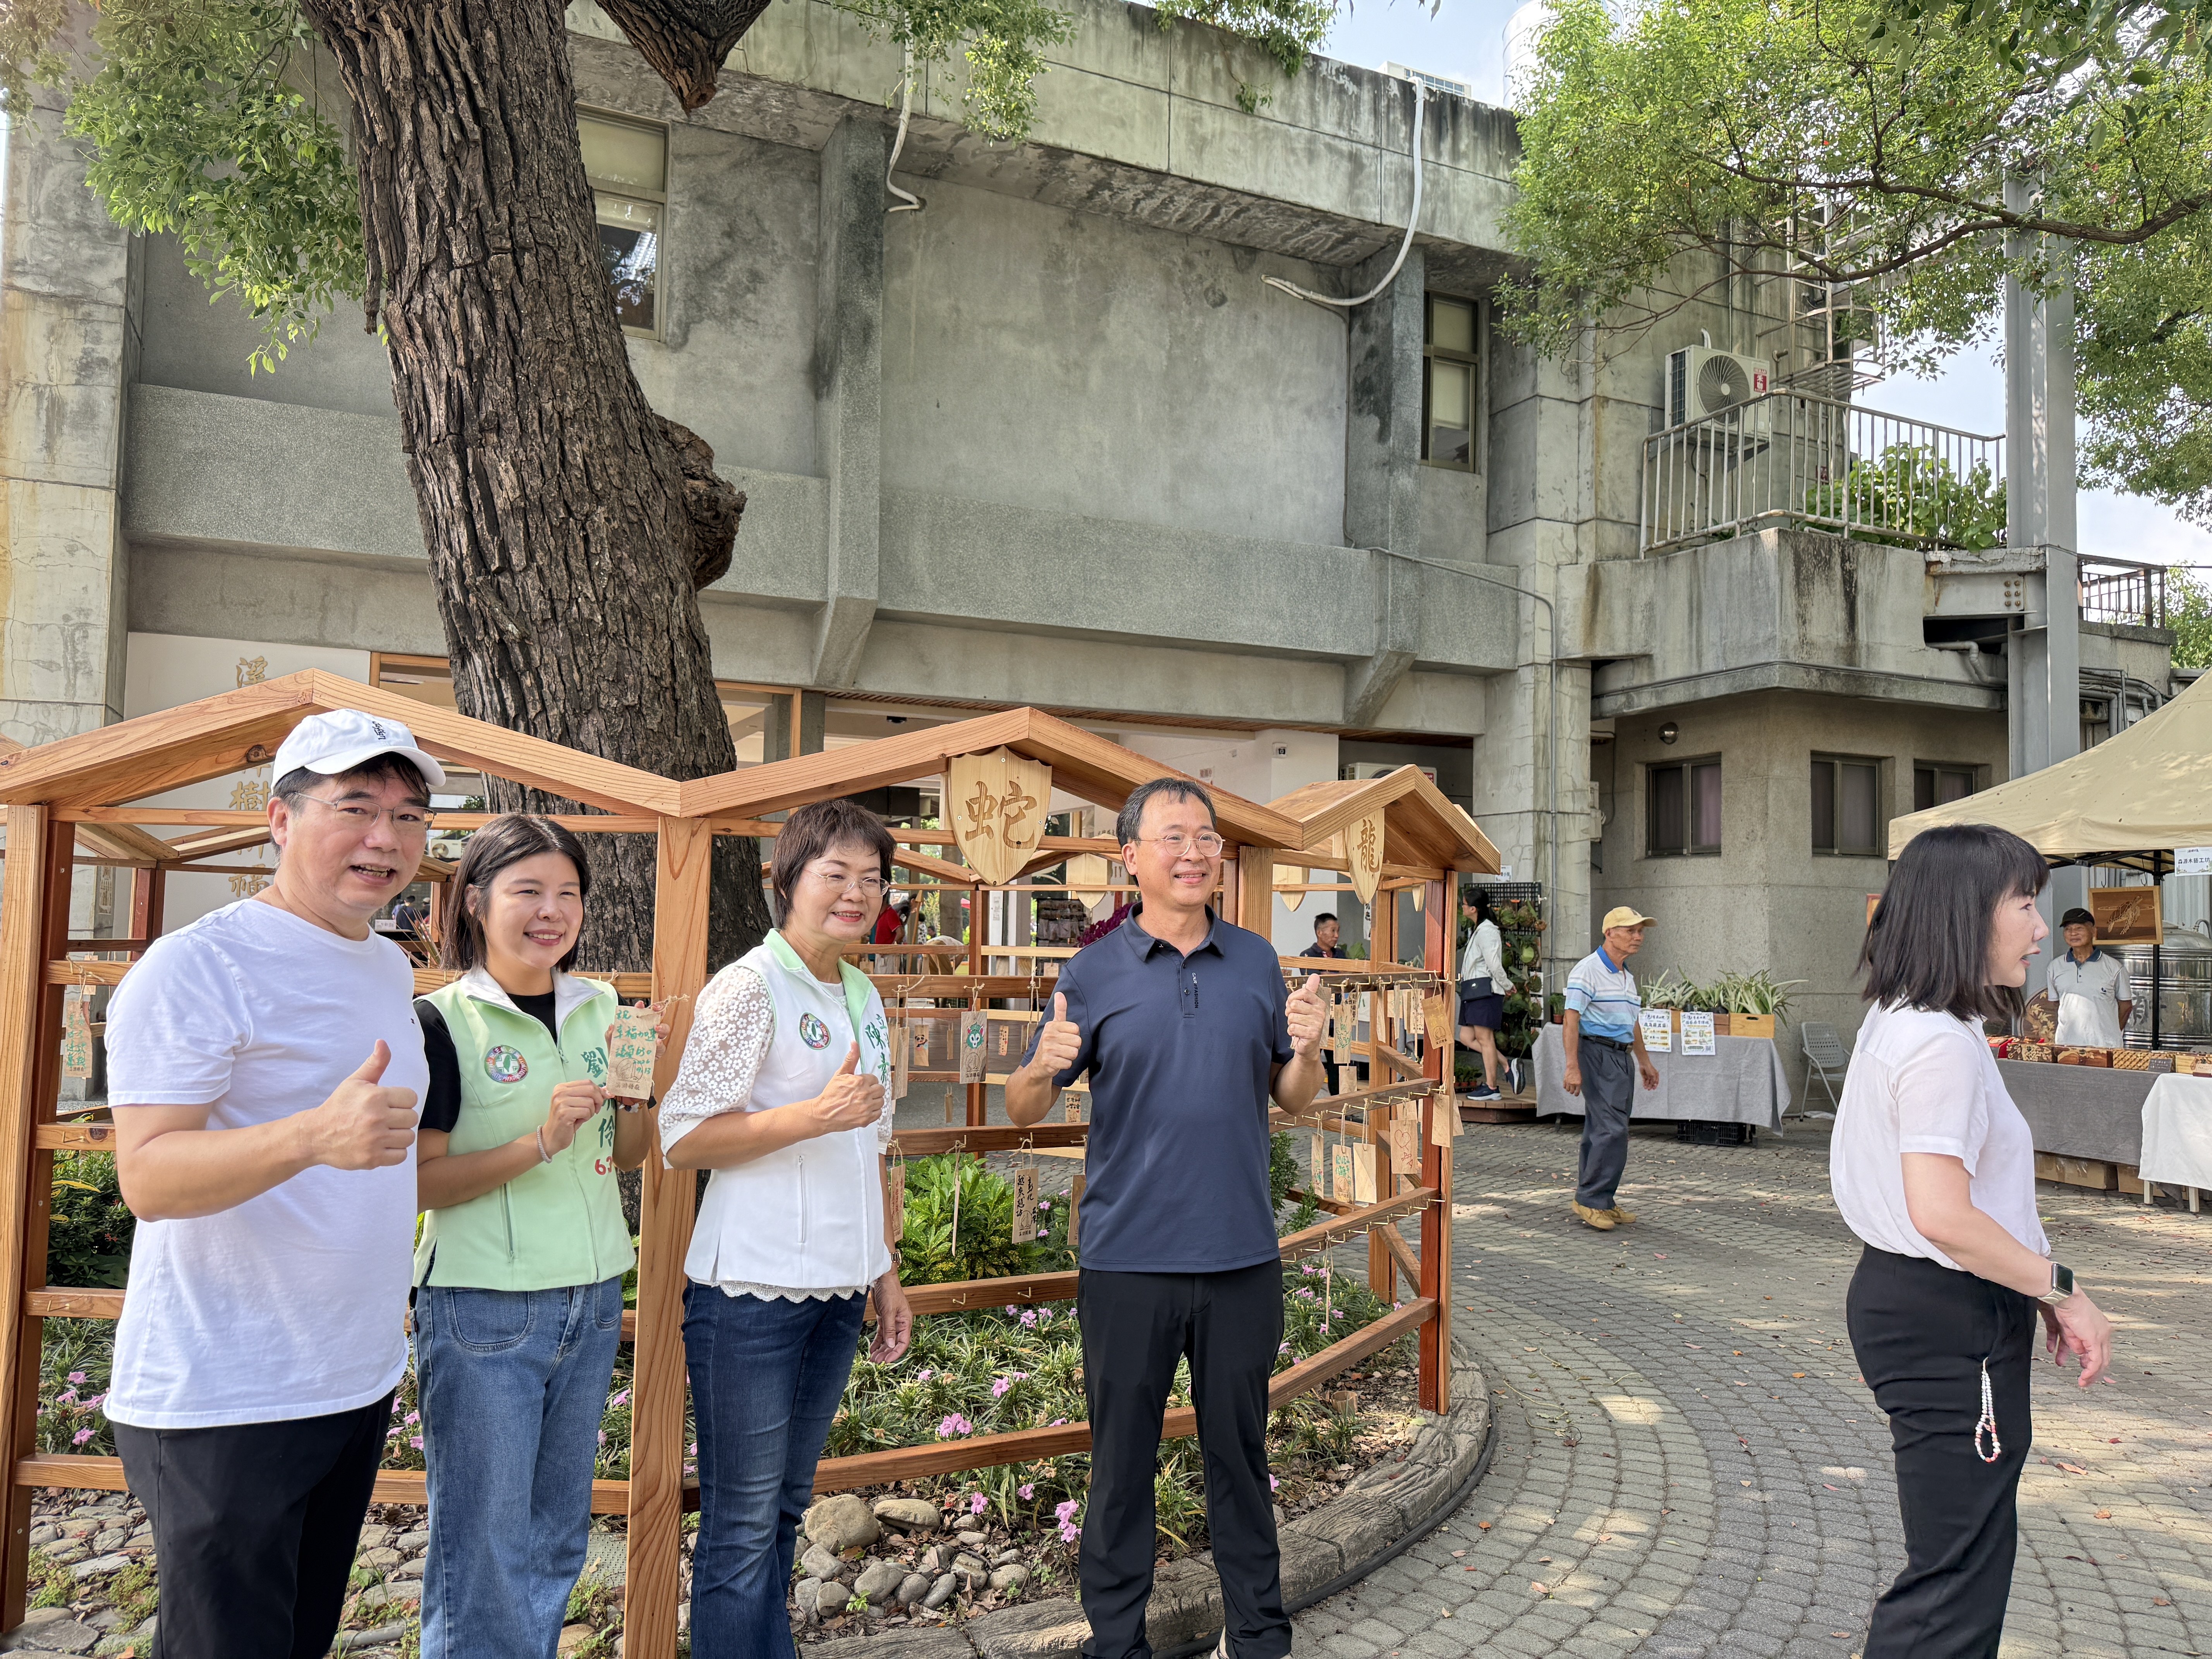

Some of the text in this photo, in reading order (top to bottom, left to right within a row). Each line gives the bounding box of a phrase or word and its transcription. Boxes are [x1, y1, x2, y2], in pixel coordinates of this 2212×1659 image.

[965, 780, 1037, 849] 蛇
[1357, 819, 1379, 873] 龍
[616, 1010, 632, 1020] 祝
